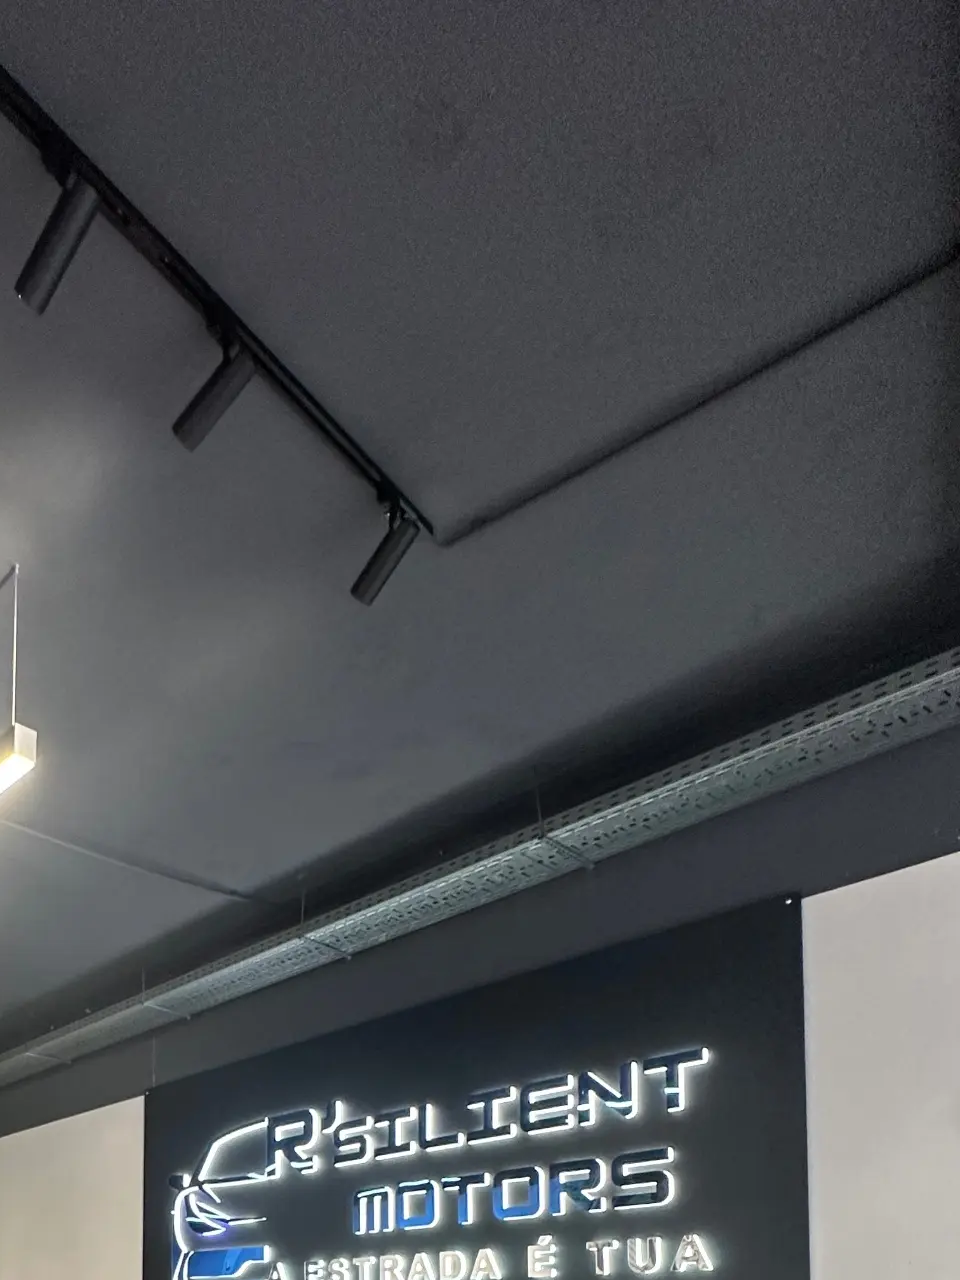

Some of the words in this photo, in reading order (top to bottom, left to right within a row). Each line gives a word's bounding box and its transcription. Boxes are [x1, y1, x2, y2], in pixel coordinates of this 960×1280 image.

[266, 1047, 709, 1179] R'SILIENT
[353, 1147, 675, 1236] MOTORS
[527, 1235, 558, 1278] É
[585, 1234, 714, 1277] TUA
